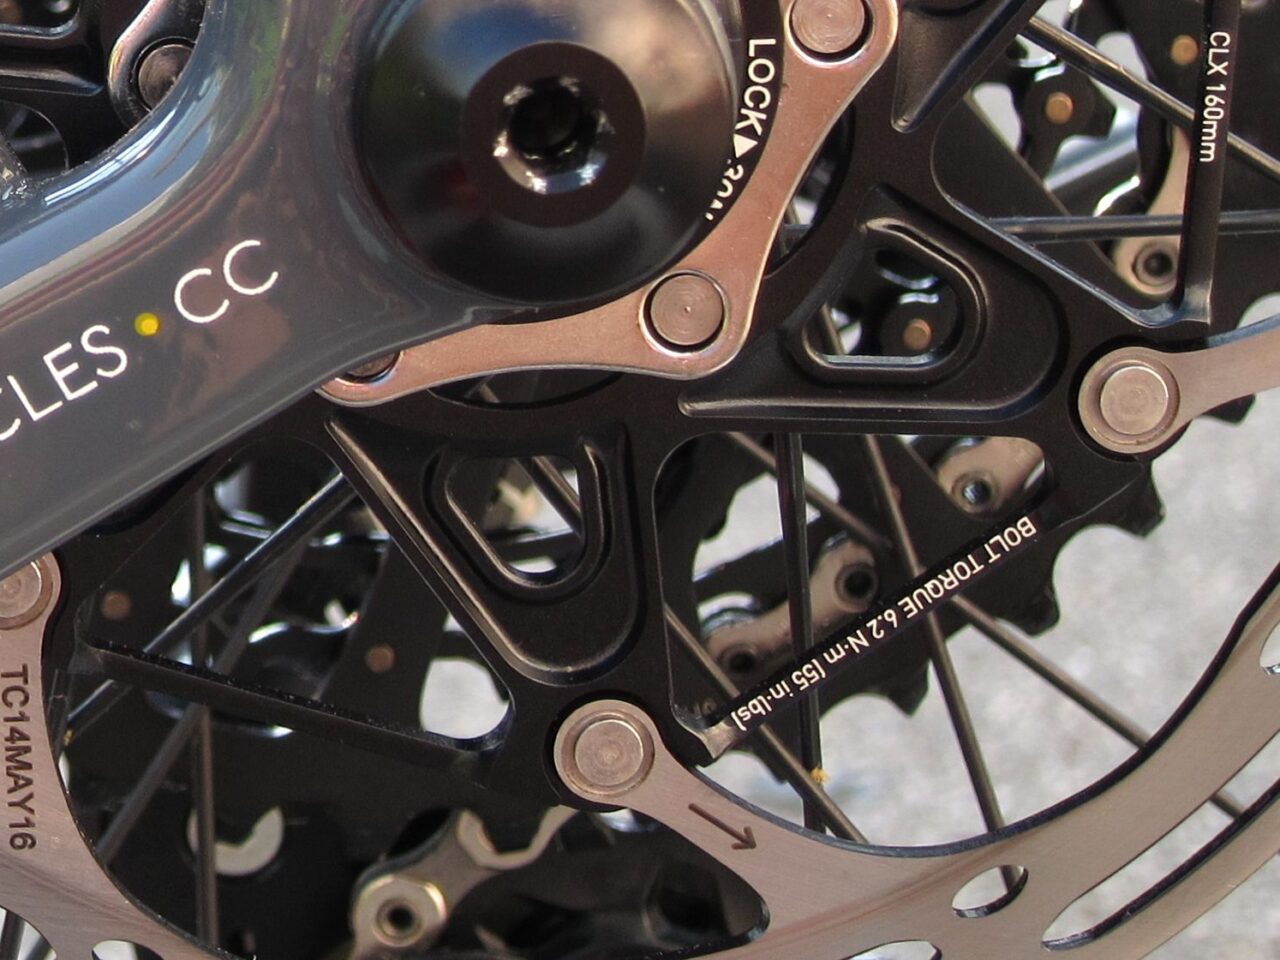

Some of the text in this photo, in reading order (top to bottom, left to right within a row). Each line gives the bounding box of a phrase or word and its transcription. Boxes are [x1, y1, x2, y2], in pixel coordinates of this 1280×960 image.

[733, 37, 777, 136] LOCK
[1199, 30, 1231, 163] CLX 160mm
[174, 239, 279, 324] CC
[983, 515, 1038, 564] BOLT
[865, 608, 899, 640] 6.2
[897, 553, 985, 620] TORQUE
[0, 662, 38, 851] TC14MAY16
